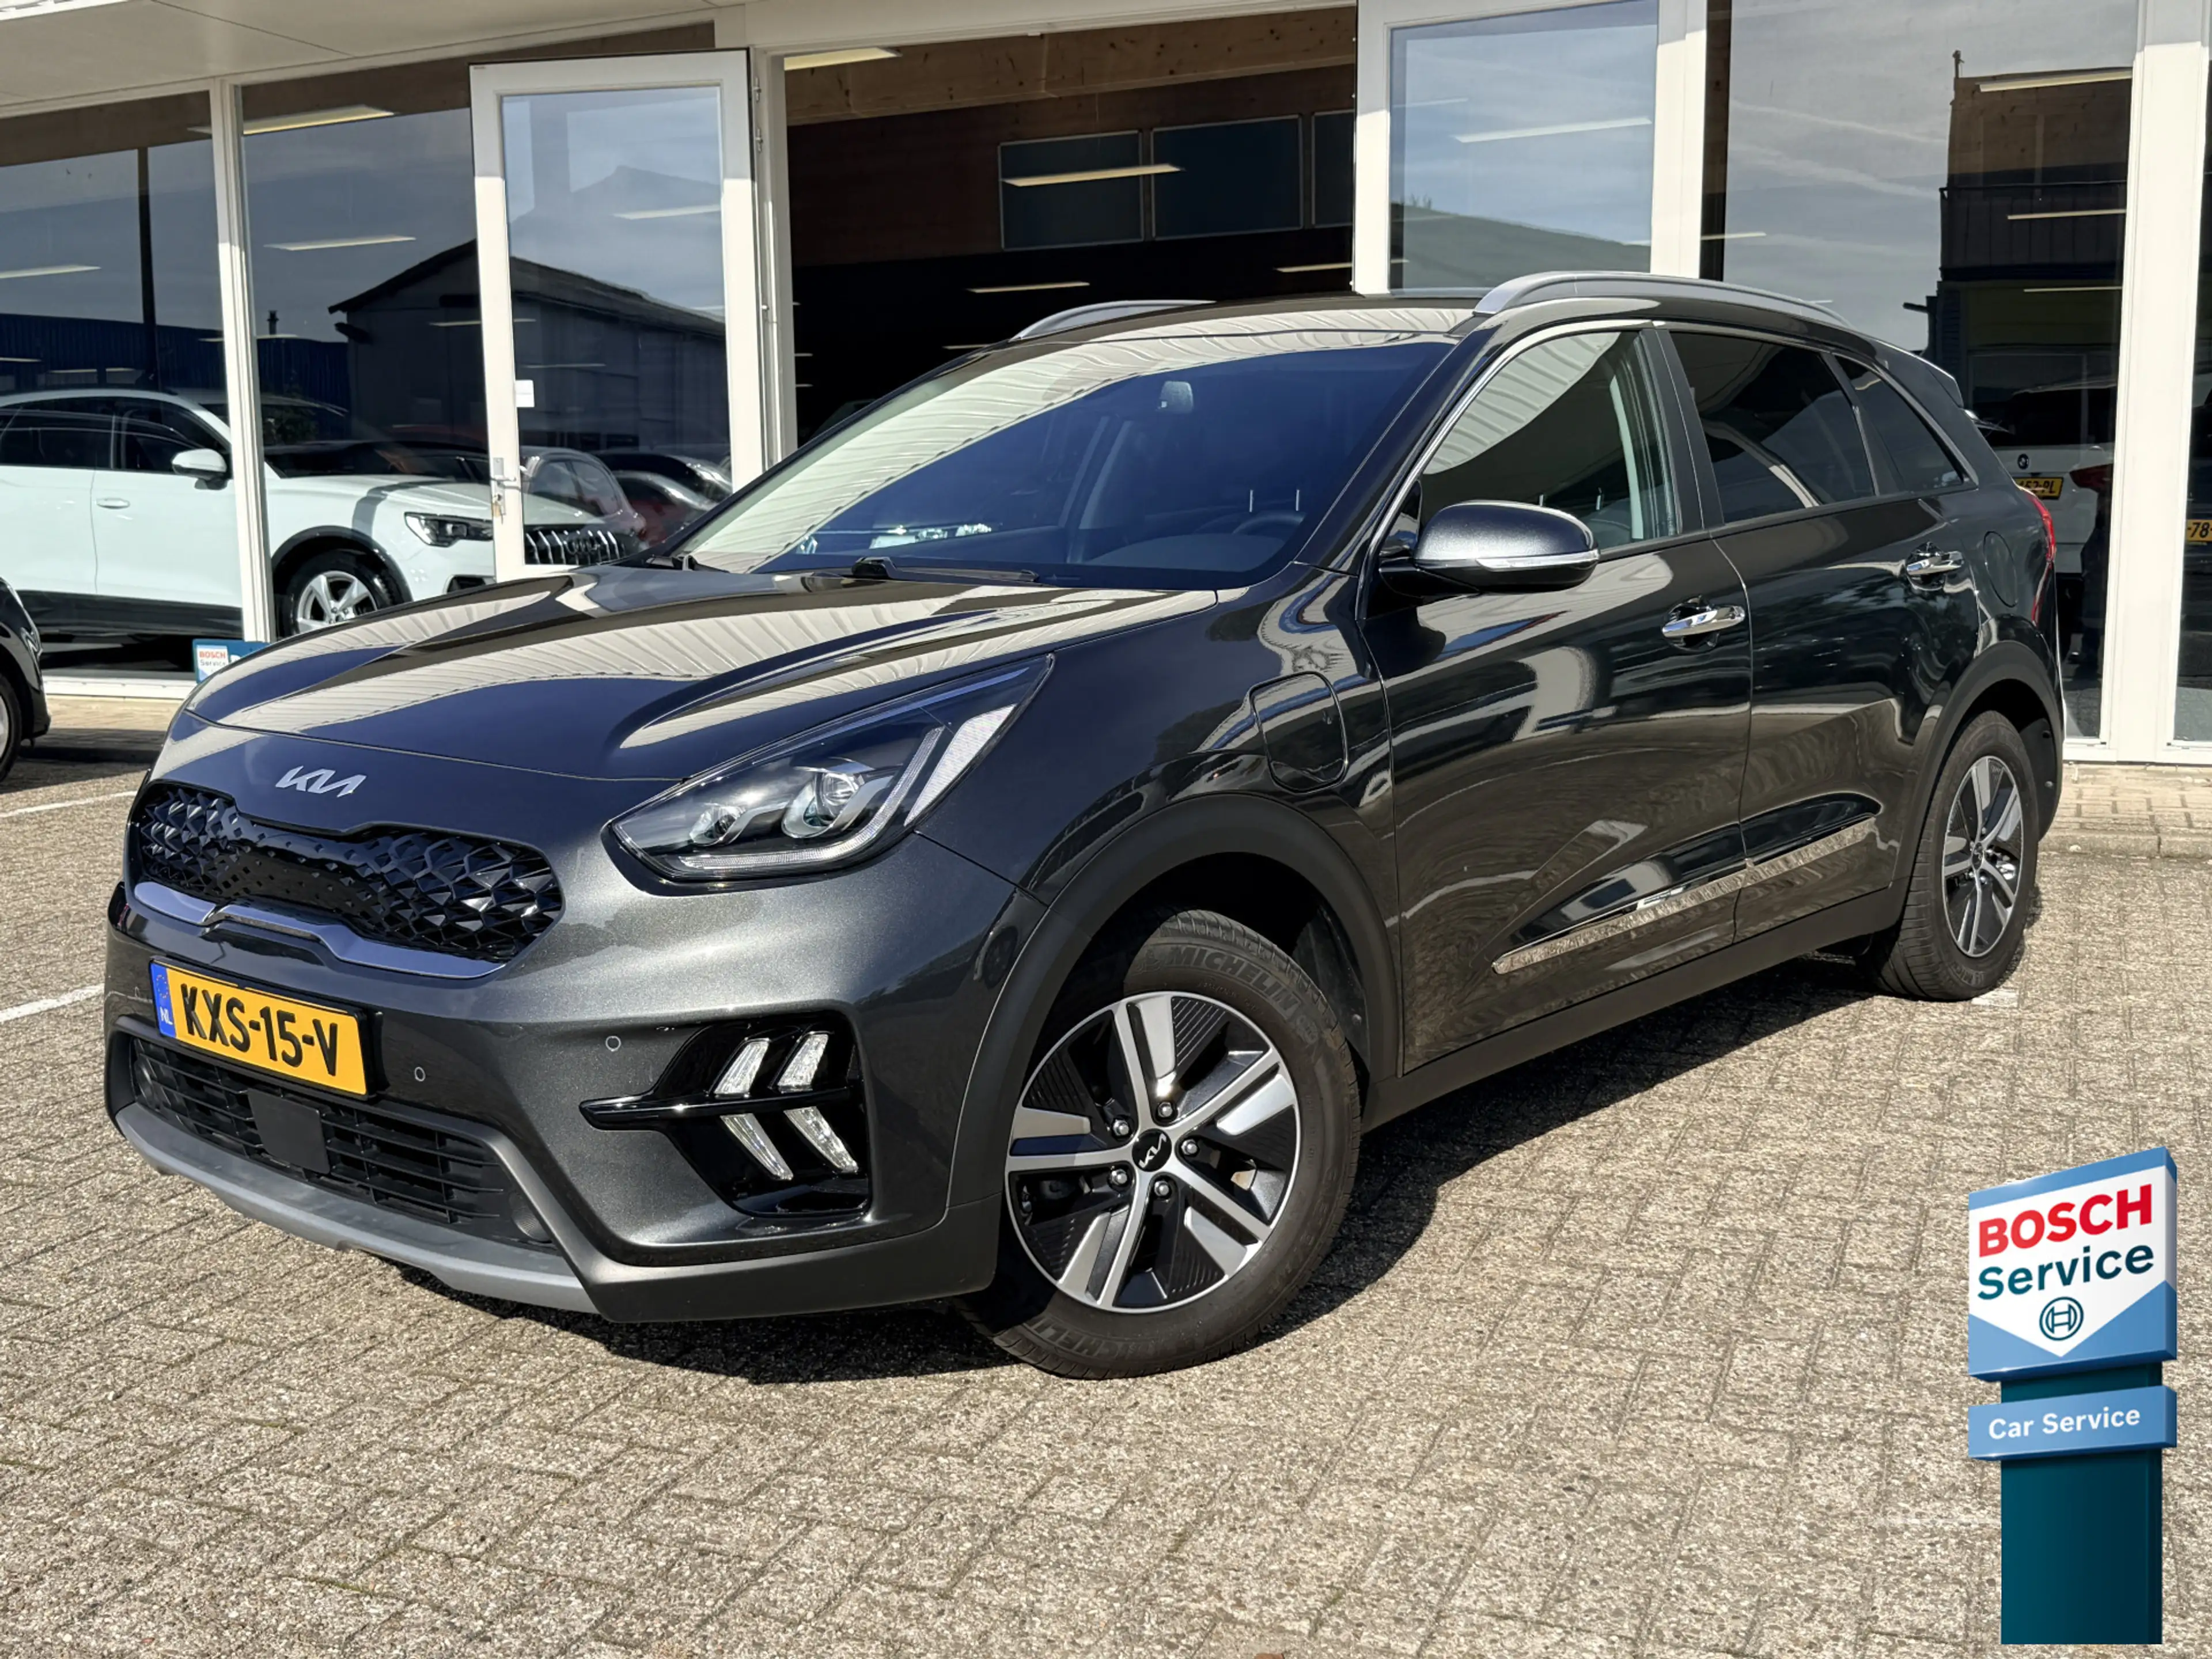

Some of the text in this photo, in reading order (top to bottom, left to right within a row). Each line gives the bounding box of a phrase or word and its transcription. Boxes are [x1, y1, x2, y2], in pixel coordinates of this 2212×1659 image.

[199, 651, 226, 659] BOSCH
[275, 764, 367, 798] KIA
[1166, 945, 1300, 1018] MICHELIN
[160, 1006, 173, 1025] NL
[180, 983, 338, 1077] KXS-15-V
